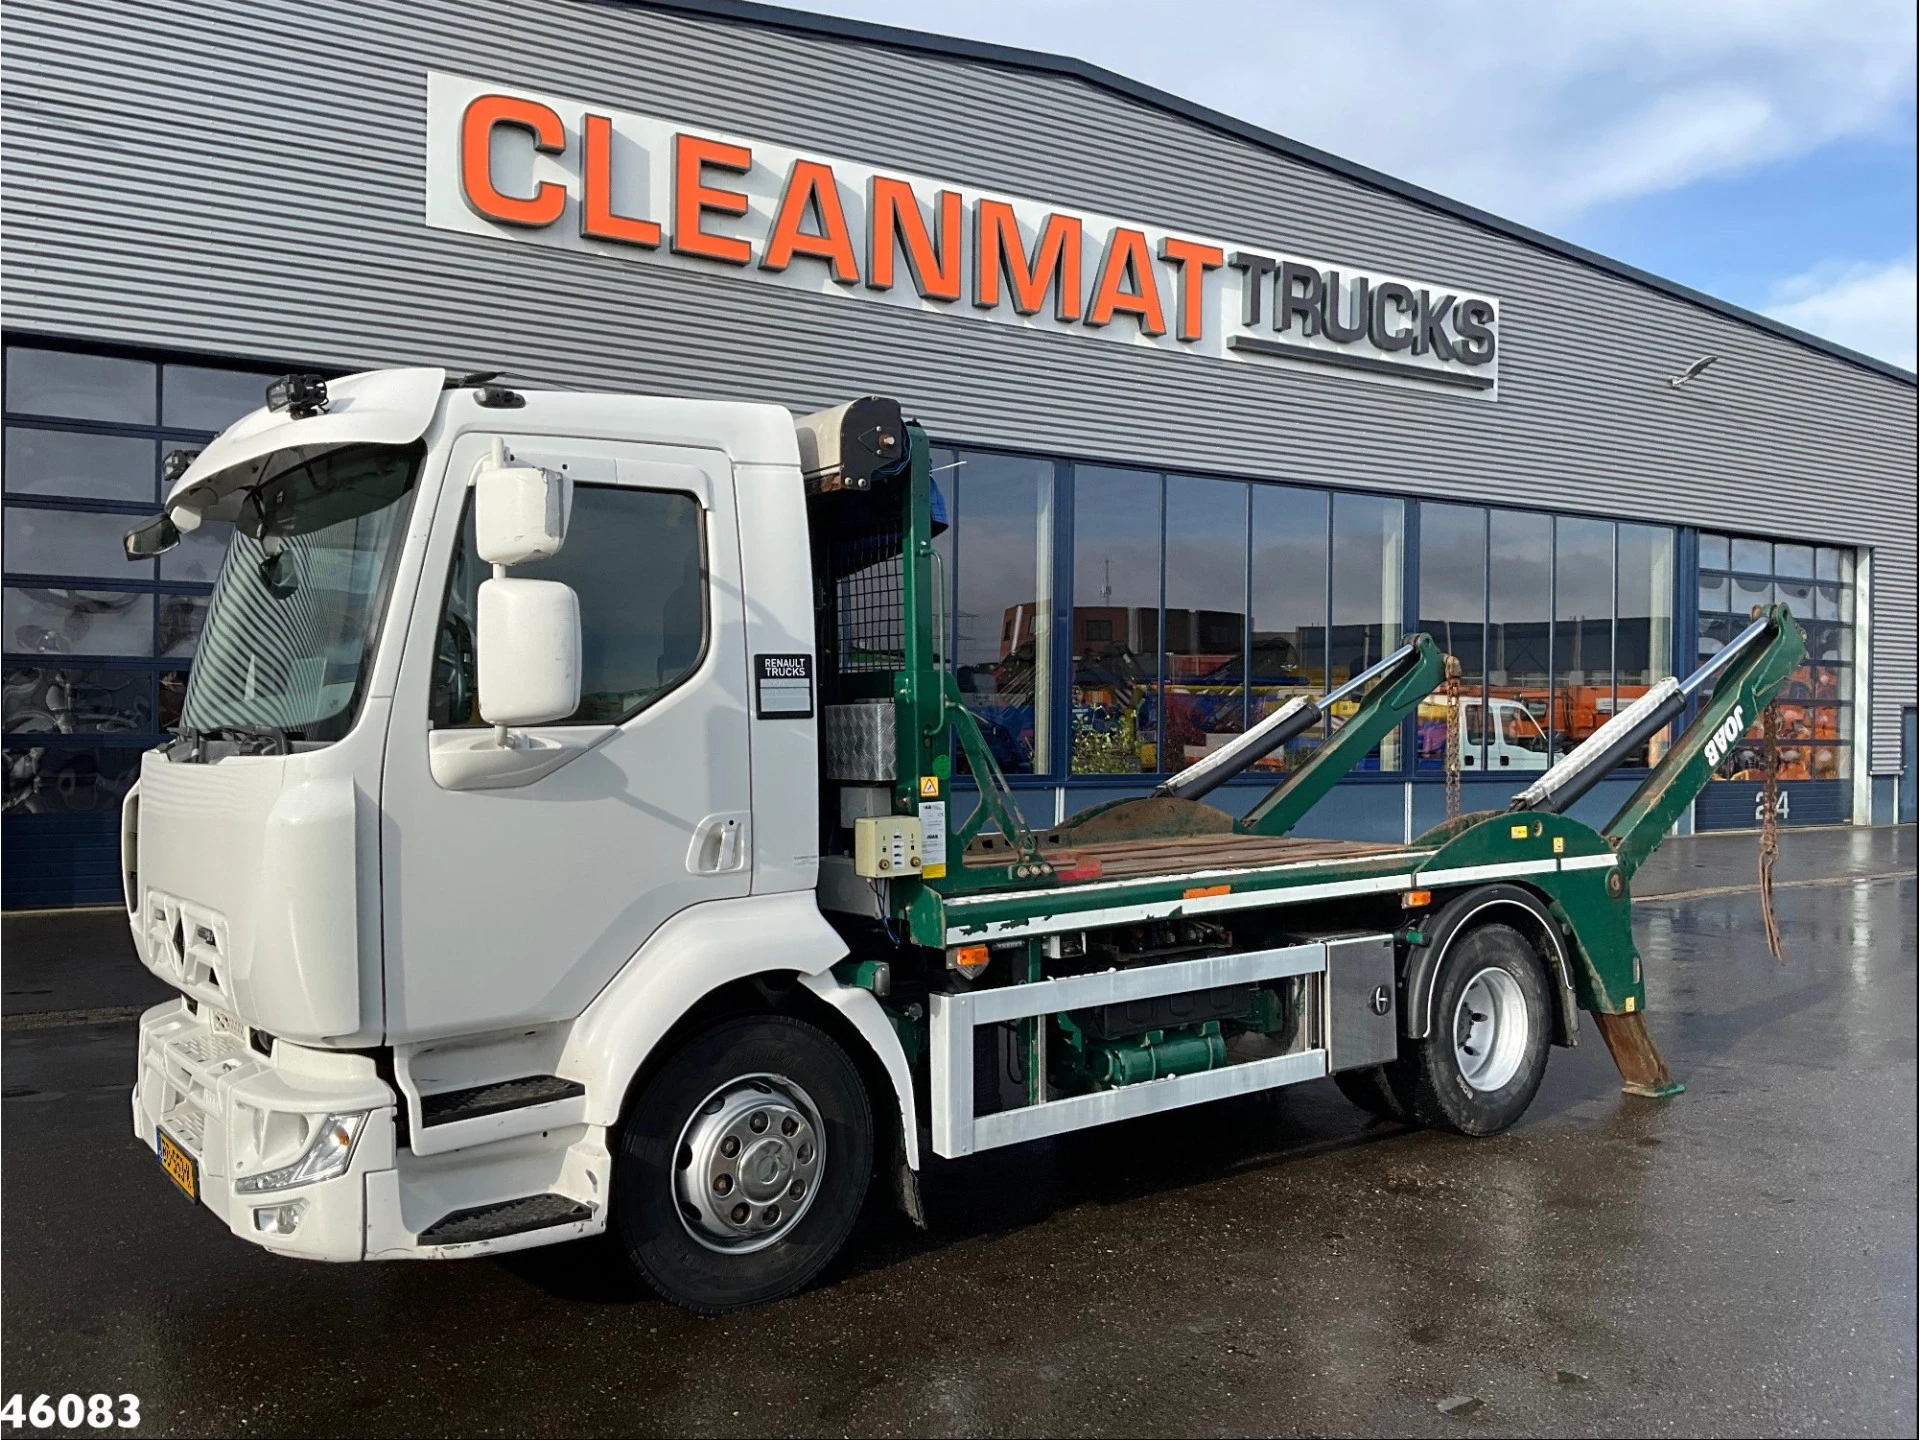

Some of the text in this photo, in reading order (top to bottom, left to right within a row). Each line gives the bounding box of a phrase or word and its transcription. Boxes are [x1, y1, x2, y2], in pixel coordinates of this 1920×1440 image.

[461, 93, 1496, 365] CLEANMAT TRUCKS
[764, 658, 806, 668] RENAULT
[765, 667, 806, 677] TRUCKS
[1704, 704, 1744, 766] JOAB
